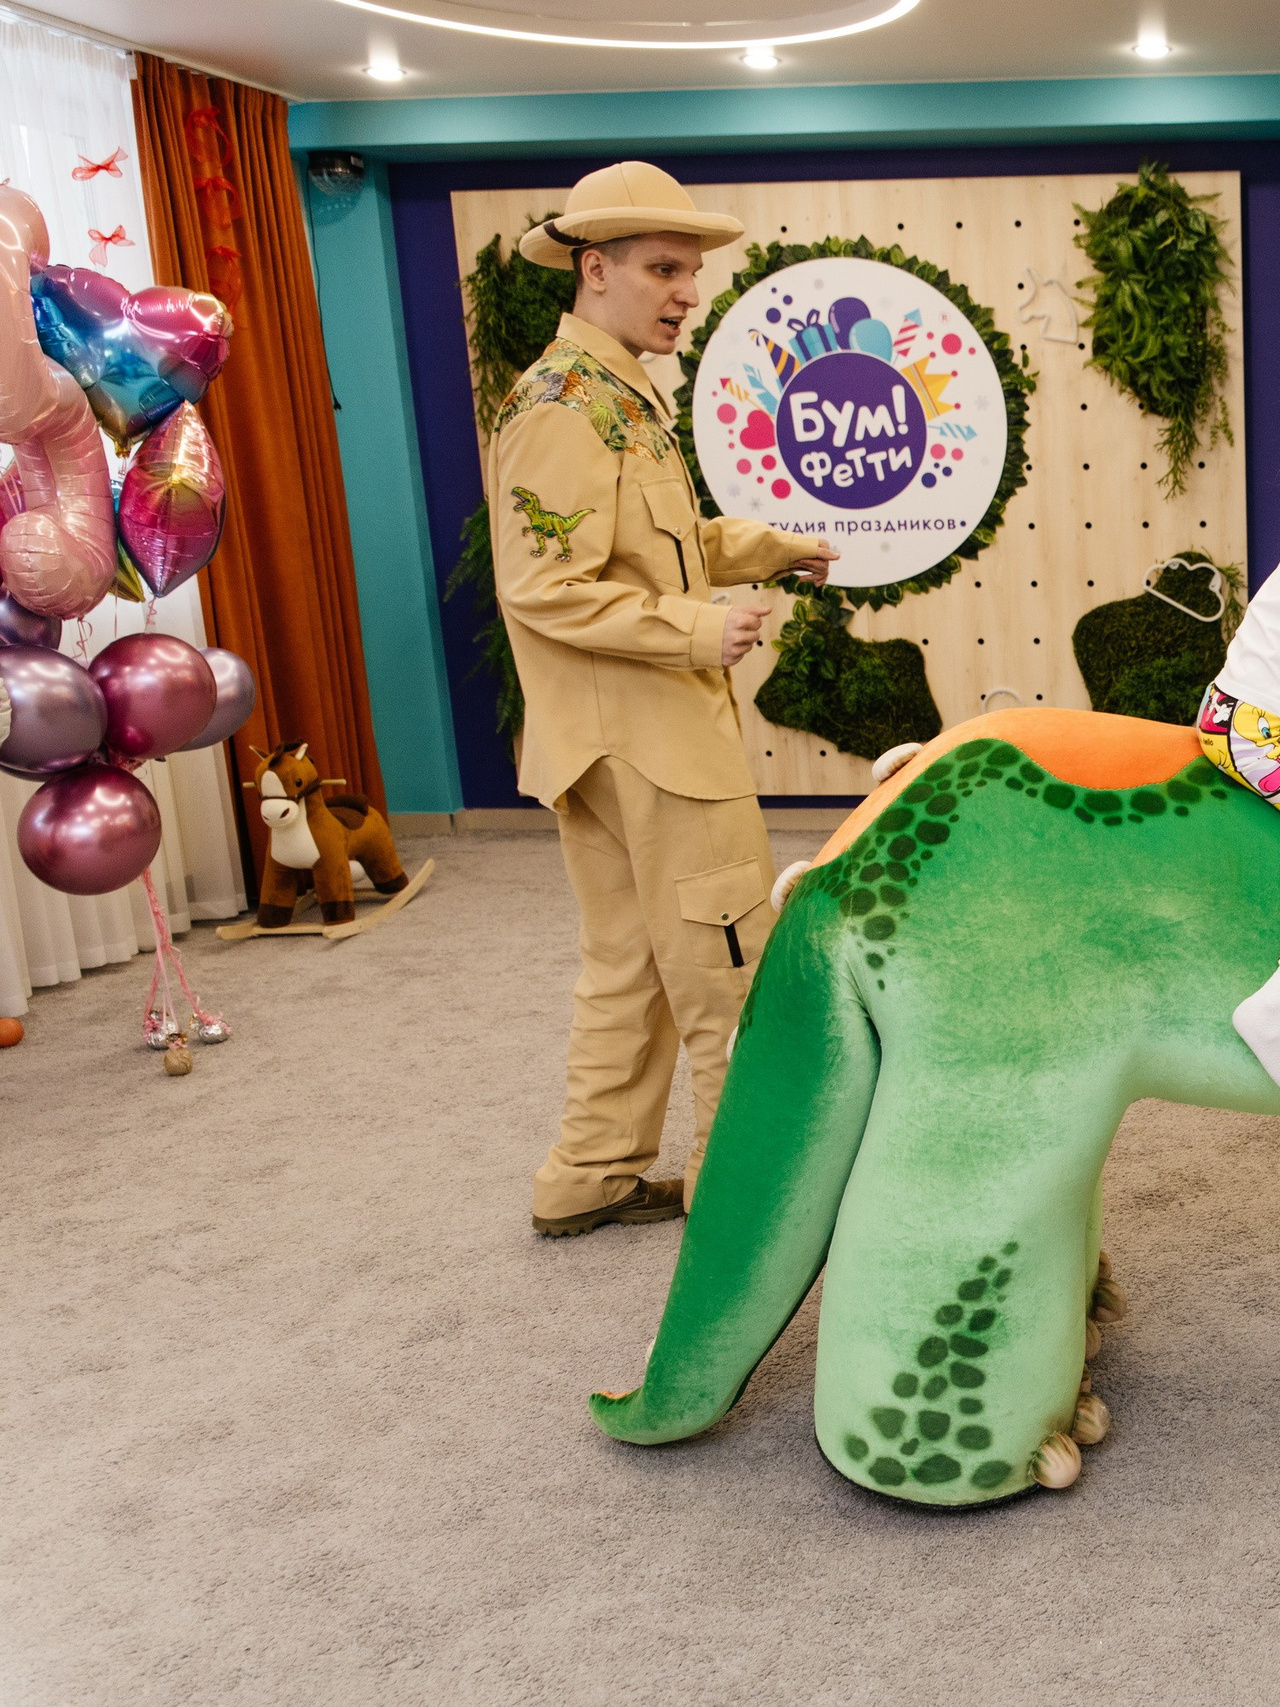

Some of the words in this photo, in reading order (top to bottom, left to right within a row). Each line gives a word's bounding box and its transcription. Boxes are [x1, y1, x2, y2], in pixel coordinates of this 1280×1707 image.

[789, 384, 909, 448] Бум!
[768, 521, 826, 535] тудия
[834, 519, 956, 535] праздников
